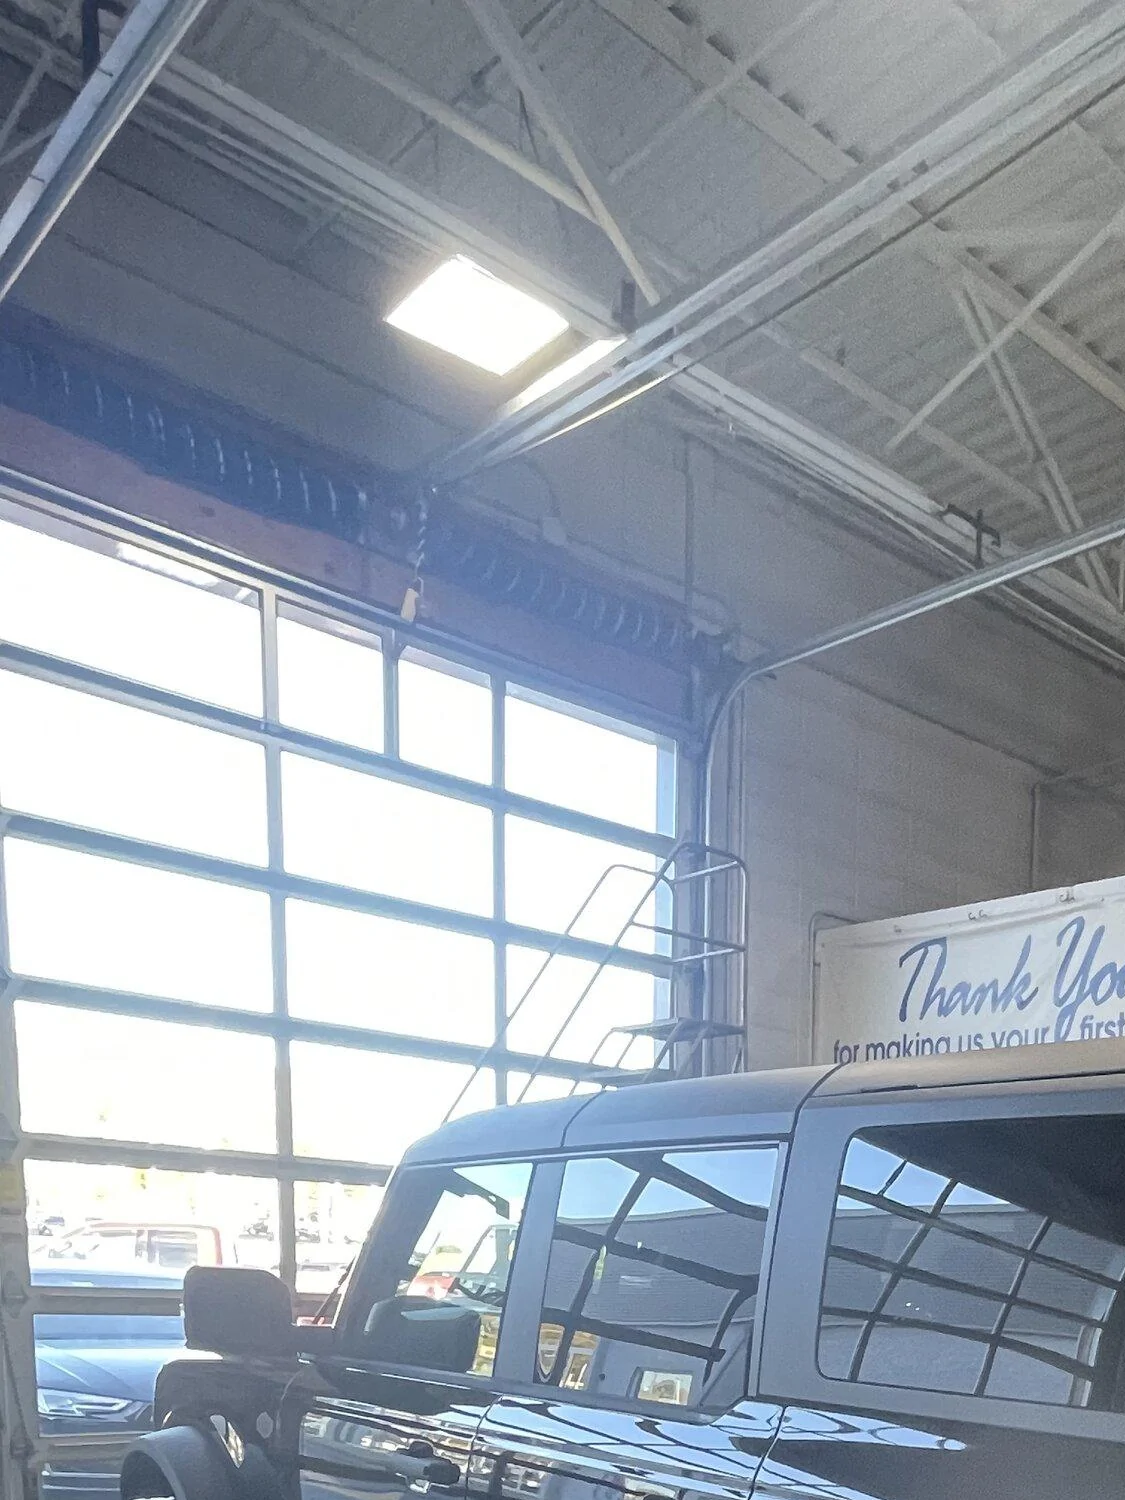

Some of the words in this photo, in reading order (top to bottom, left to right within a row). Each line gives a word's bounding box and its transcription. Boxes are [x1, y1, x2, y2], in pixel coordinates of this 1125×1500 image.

[898, 935, 1039, 1023] Thank
[833, 1039, 860, 1065] for
[865, 1031, 951, 1062] making
[958, 1032, 984, 1053] us
[990, 1024, 1051, 1050] your
